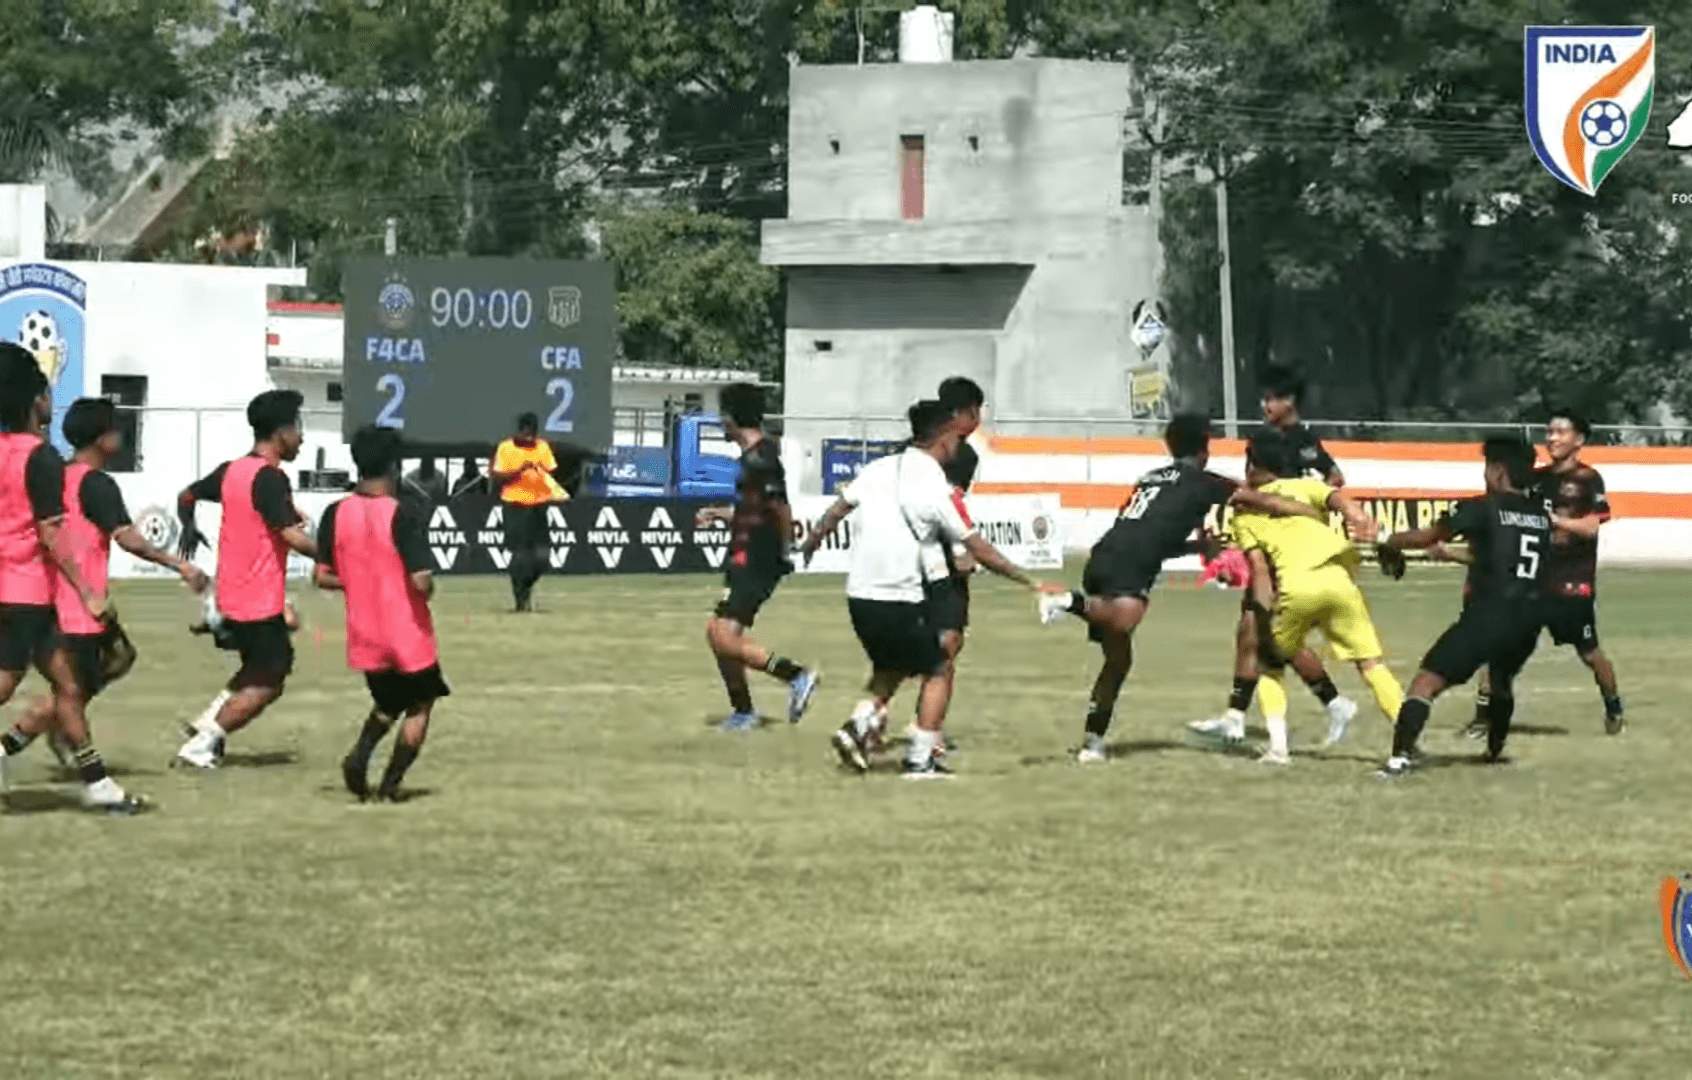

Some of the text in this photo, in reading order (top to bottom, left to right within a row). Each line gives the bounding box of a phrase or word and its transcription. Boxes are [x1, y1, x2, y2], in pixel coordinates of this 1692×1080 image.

[431, 287, 532, 328] 90:00
[366, 337, 425, 361] F4CA
[541, 346, 582, 370] CFA
[376, 373, 405, 428] 2
[545, 378, 574, 432] 2
[477, 531, 505, 544] NIV
[549, 531, 576, 544] VIA
[587, 531, 630, 544] NIVIA
[641, 531, 683, 544] NIVIA
[1517, 534, 1540, 580] 5
